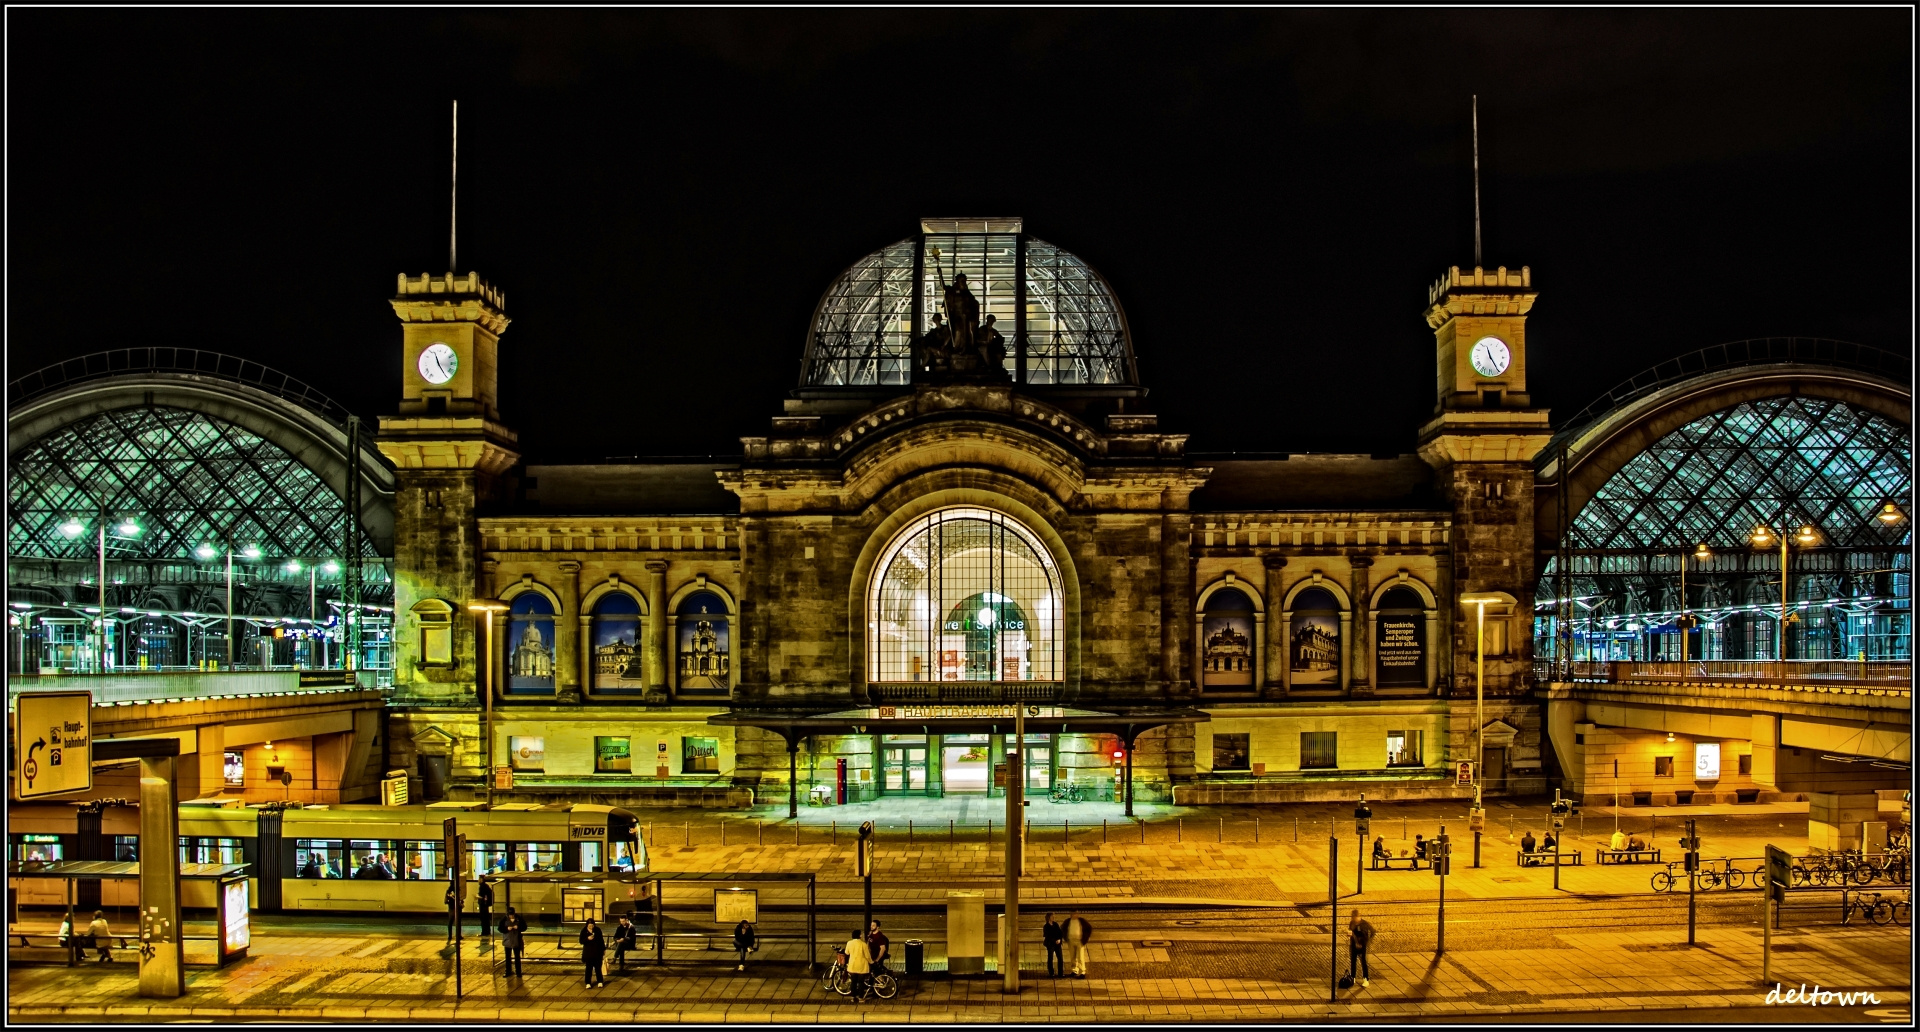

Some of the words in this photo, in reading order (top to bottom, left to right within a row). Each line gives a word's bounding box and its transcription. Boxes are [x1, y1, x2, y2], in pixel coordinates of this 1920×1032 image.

[880, 707, 894, 716] DB
[1030, 705, 1039, 716] S
[64, 721, 84, 734] Haupt-
[64, 735, 87, 749] bahnhof
[600, 745, 628, 753] SUBWAY
[583, 827, 606, 836] DVB
